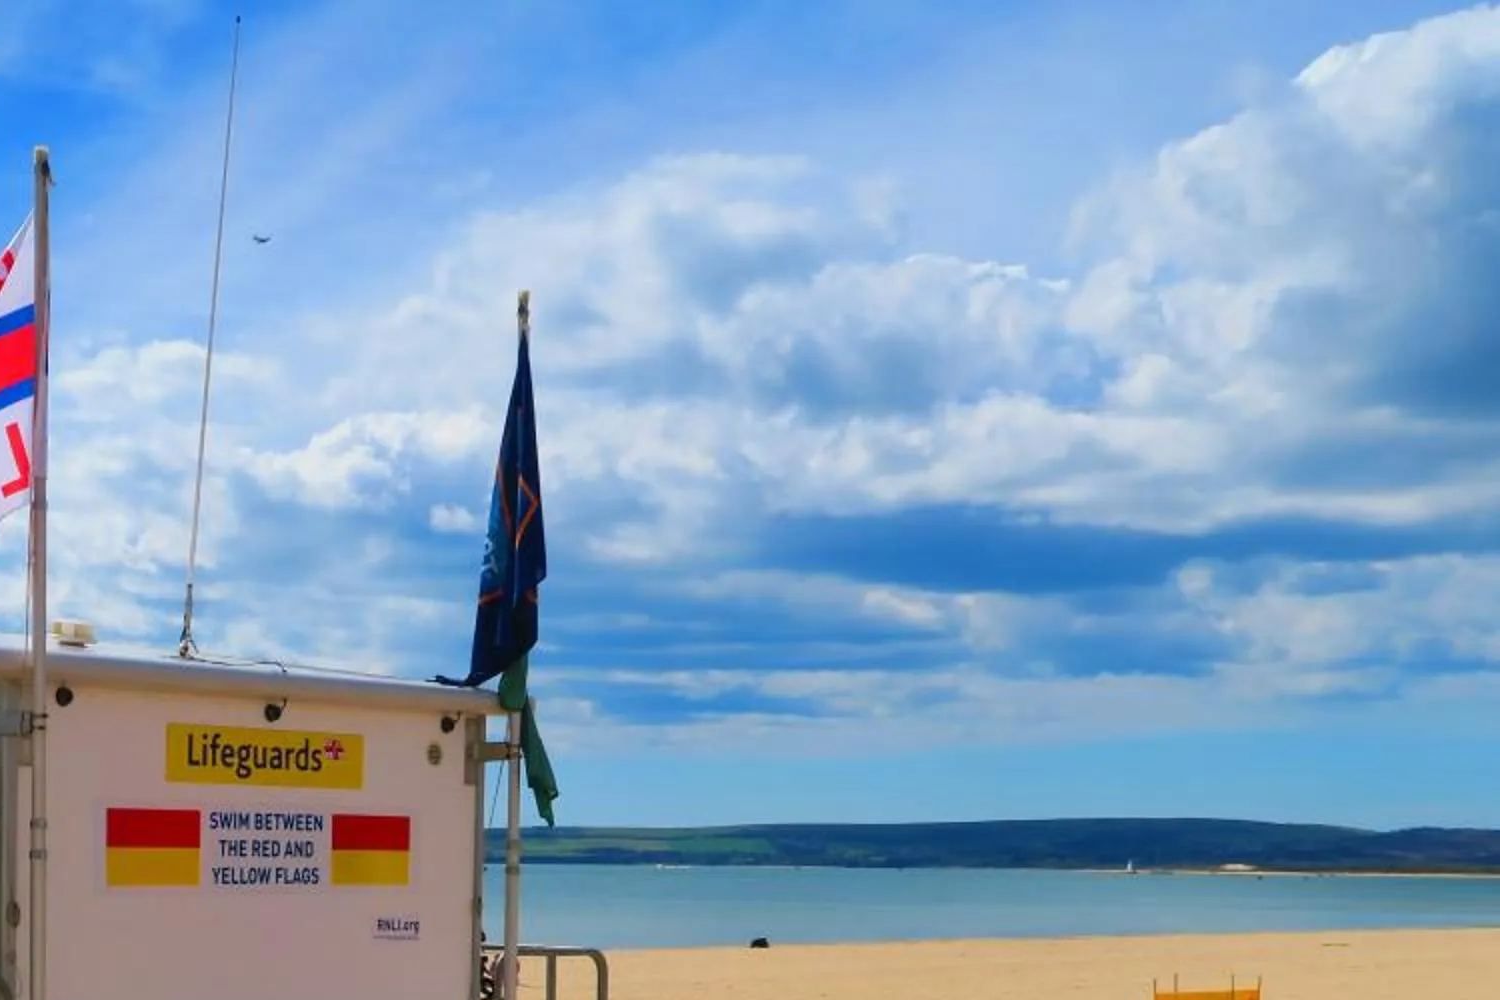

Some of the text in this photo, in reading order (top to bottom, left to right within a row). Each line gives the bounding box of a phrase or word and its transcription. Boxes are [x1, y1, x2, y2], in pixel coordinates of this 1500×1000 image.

[187, 733, 322, 779] Lifeguards
[209, 811, 324, 831] SWIM BETWEEN
[219, 839, 314, 858] THE RED AND
[212, 867, 320, 884] YELLOW FLAGS
